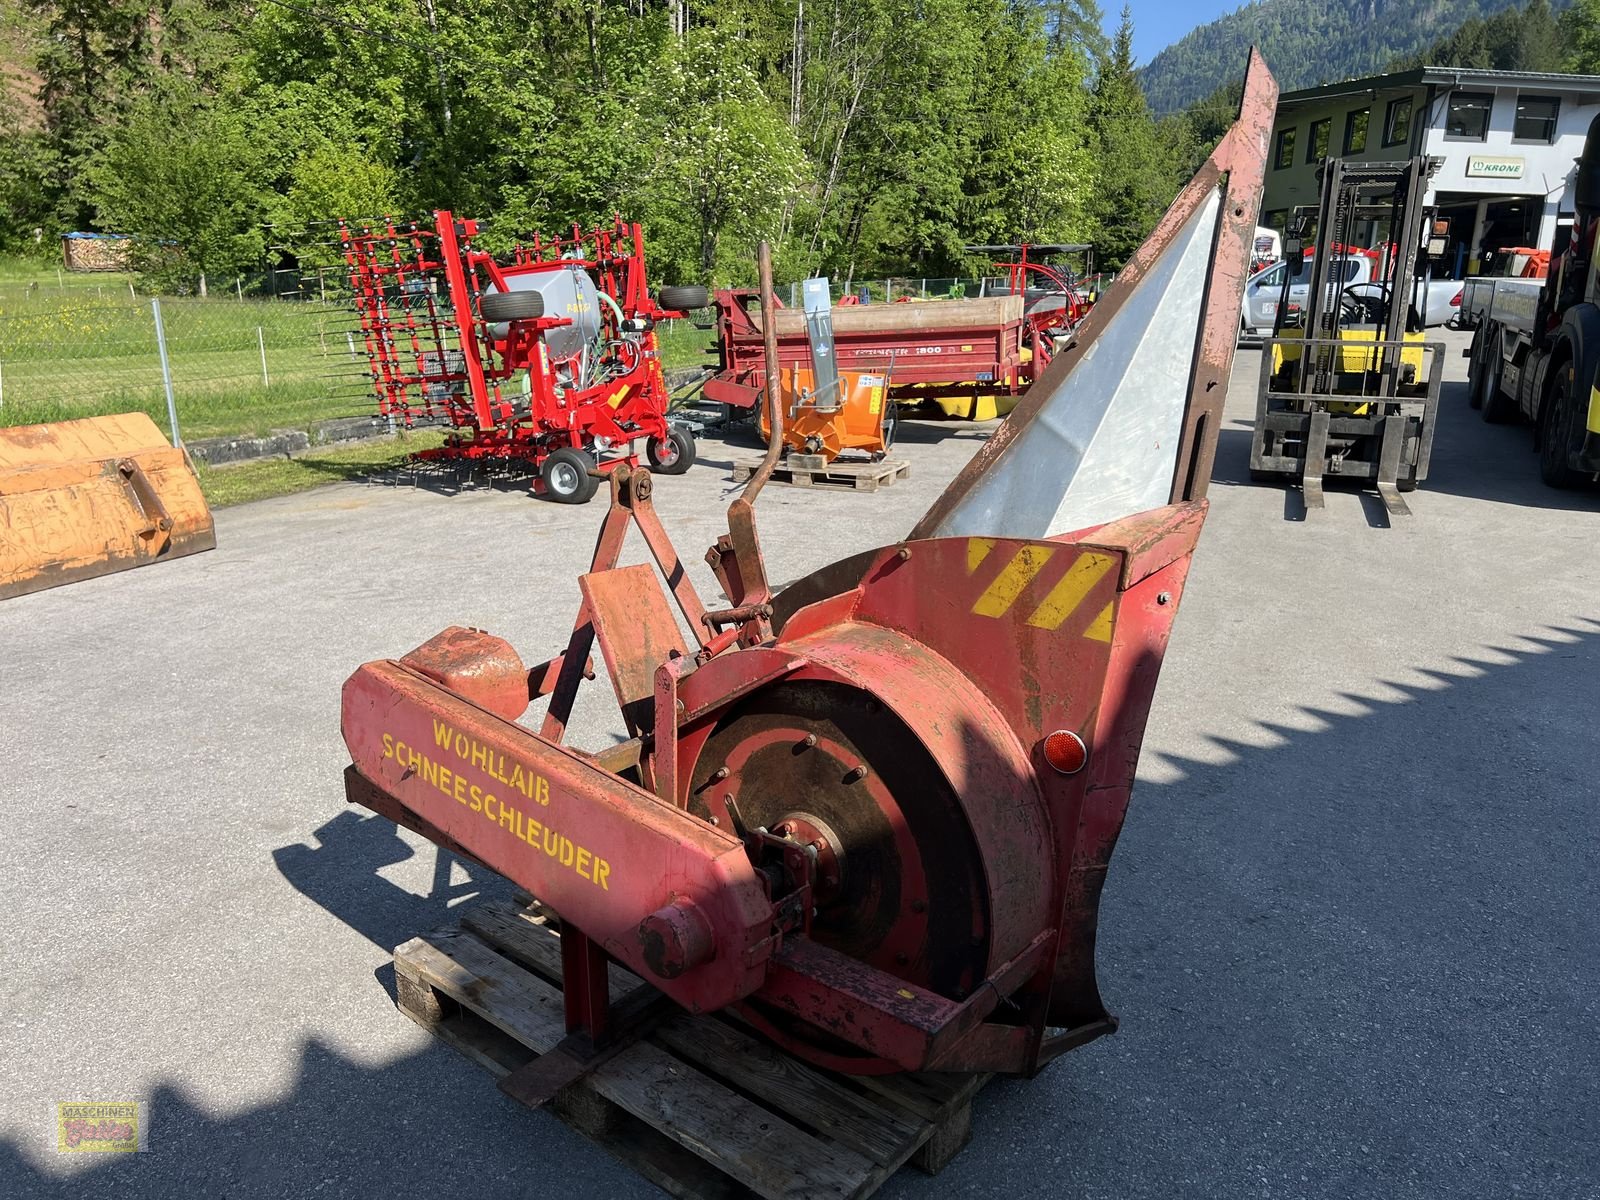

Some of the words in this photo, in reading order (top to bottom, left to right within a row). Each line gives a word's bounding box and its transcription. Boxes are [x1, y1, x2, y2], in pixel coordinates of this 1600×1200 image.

[1484, 164, 1521, 172] KRONE
[432, 719, 550, 807] WOHLLAIB
[382, 732, 610, 891] SCHNEESCHLEUDER
